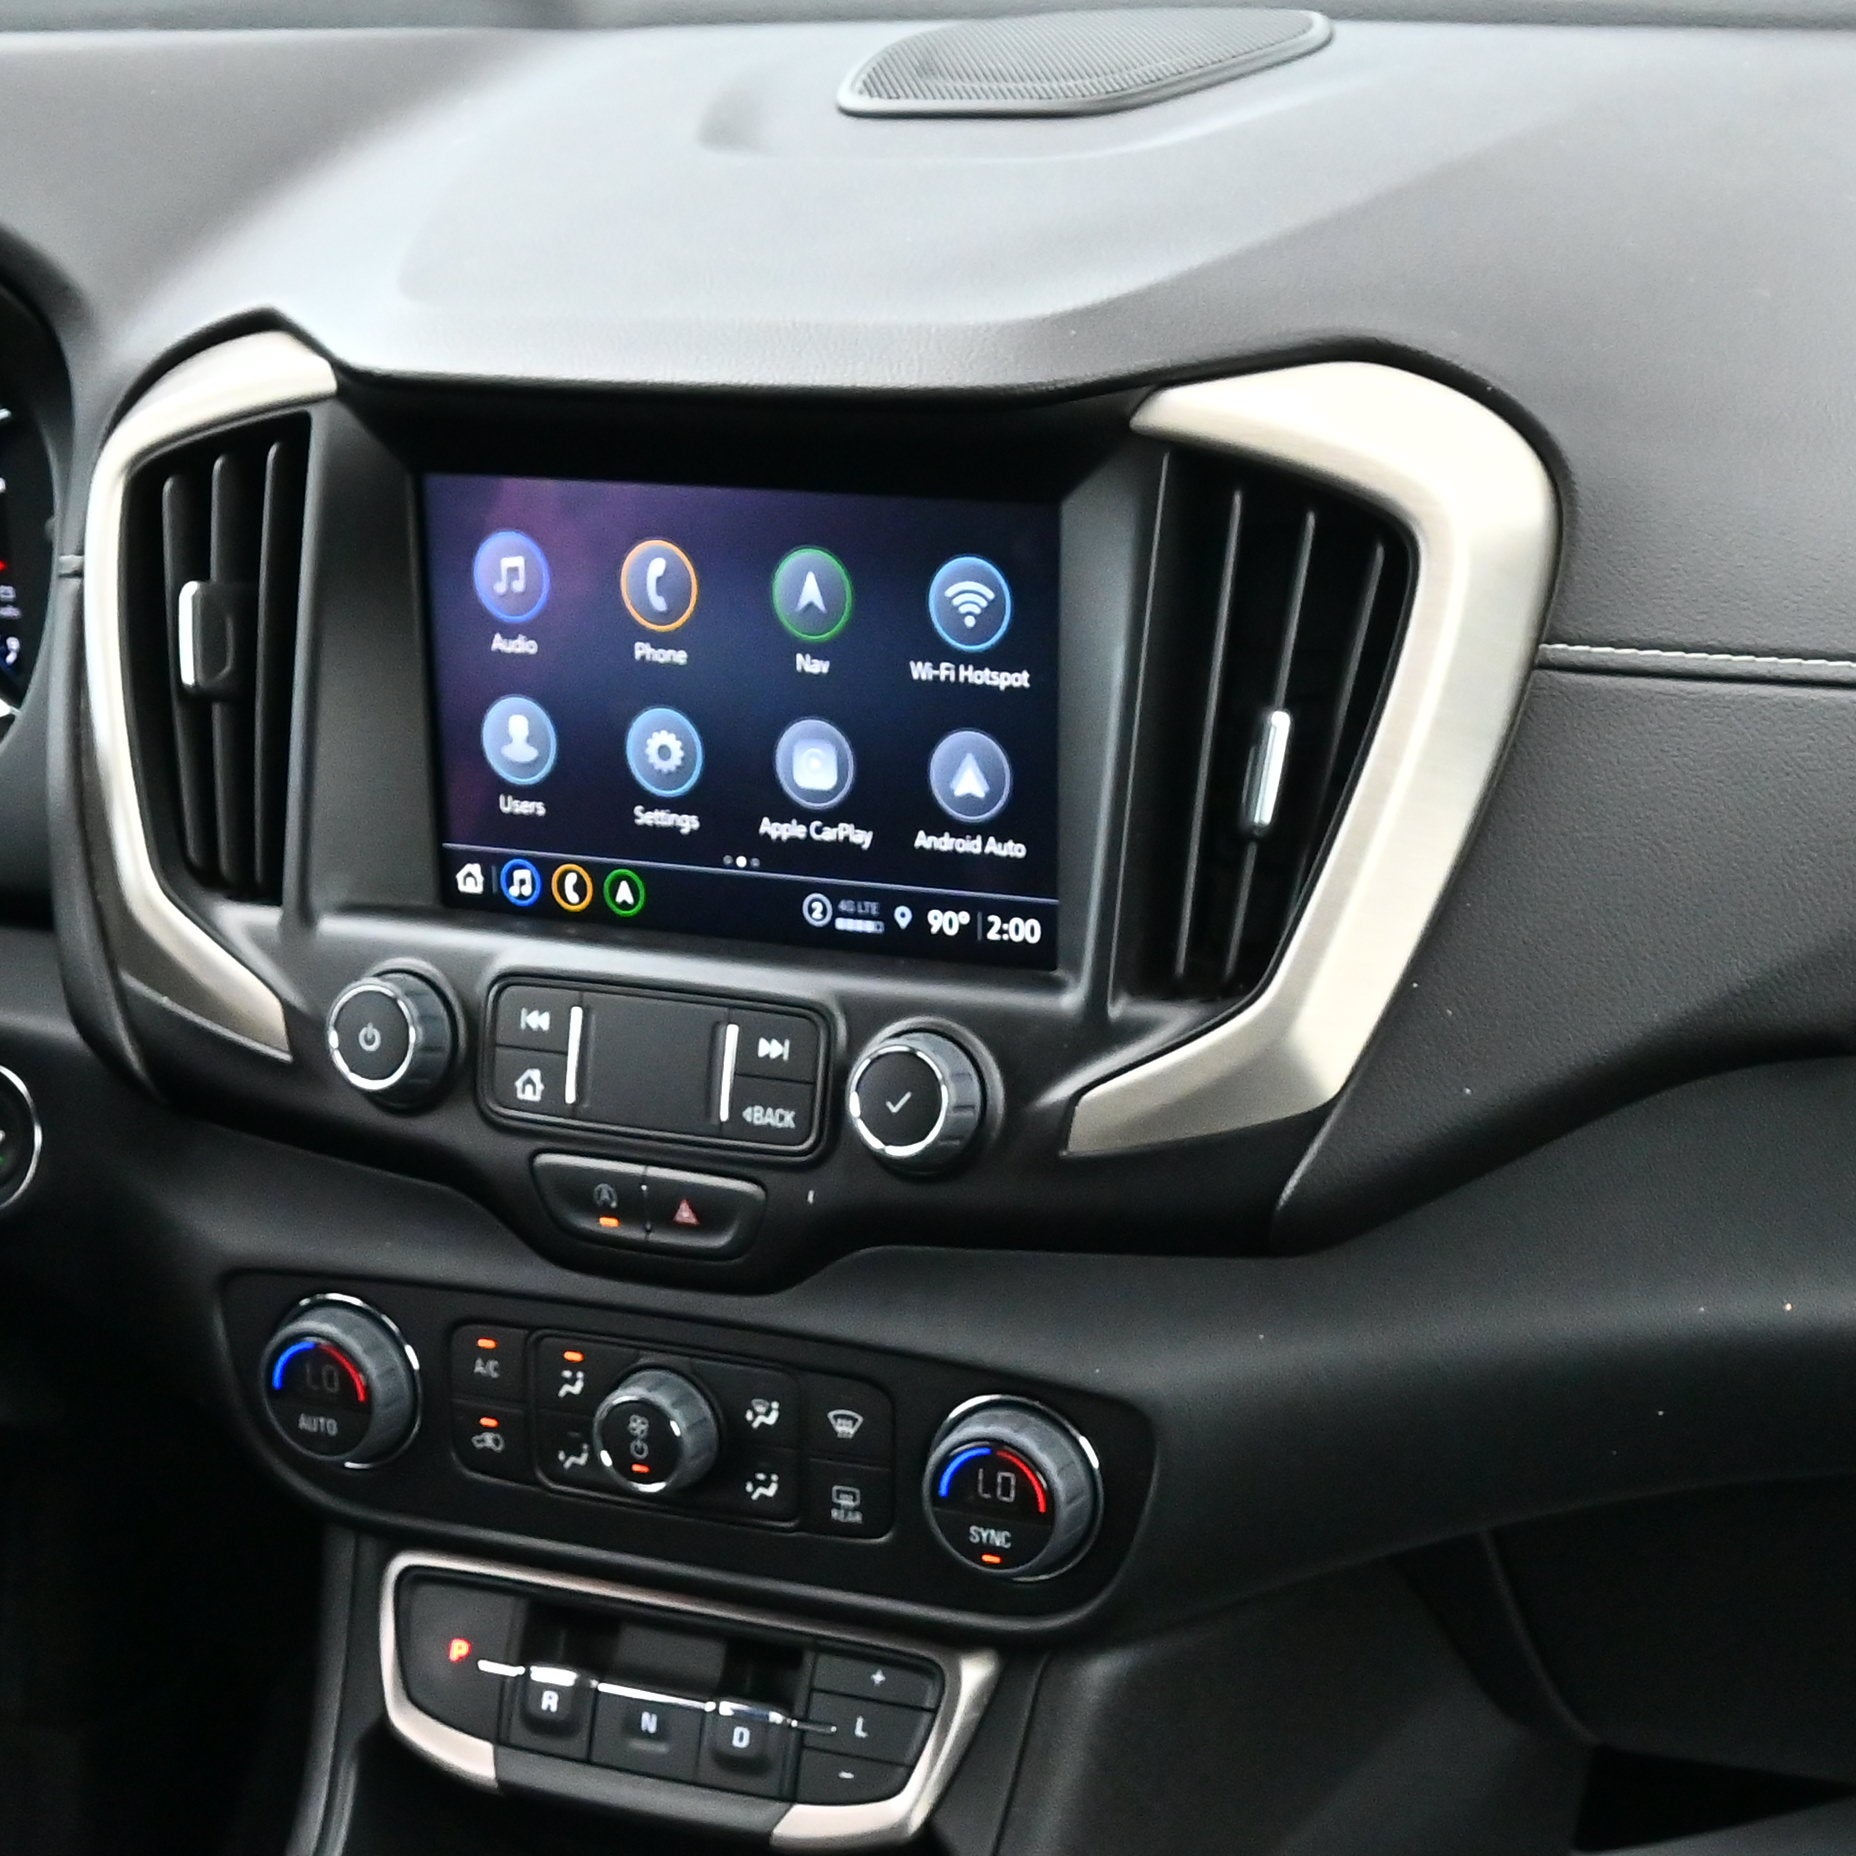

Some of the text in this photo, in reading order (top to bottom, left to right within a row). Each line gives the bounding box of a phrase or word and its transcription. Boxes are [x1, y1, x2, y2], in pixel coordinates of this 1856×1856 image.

[491, 632, 539, 655] Audio
[634, 641, 688, 665] Phone
[796, 653, 830, 674] Nav
[909, 660, 1030, 690] Wi-Fi Hotspot
[499, 794, 546, 816] Users
[633, 805, 700, 834] Settings
[759, 816, 874, 850] Apple CarPlay
[914, 830, 1026, 858] Android Auto
[857, 901, 879, 916] LTE
[986, 914, 1042, 944] 2:00
[752, 1105, 796, 1129] BACK
[298, 1413, 338, 1436] AUTO
[978, 1468, 1016, 1503] LO
[969, 1525, 1012, 1549] SYNC
[448, 1637, 473, 1662] P
[541, 1690, 558, 1713] R
[640, 1711, 658, 1735] N
[855, 1716, 868, 1738] L
[732, 1726, 750, 1749] D
